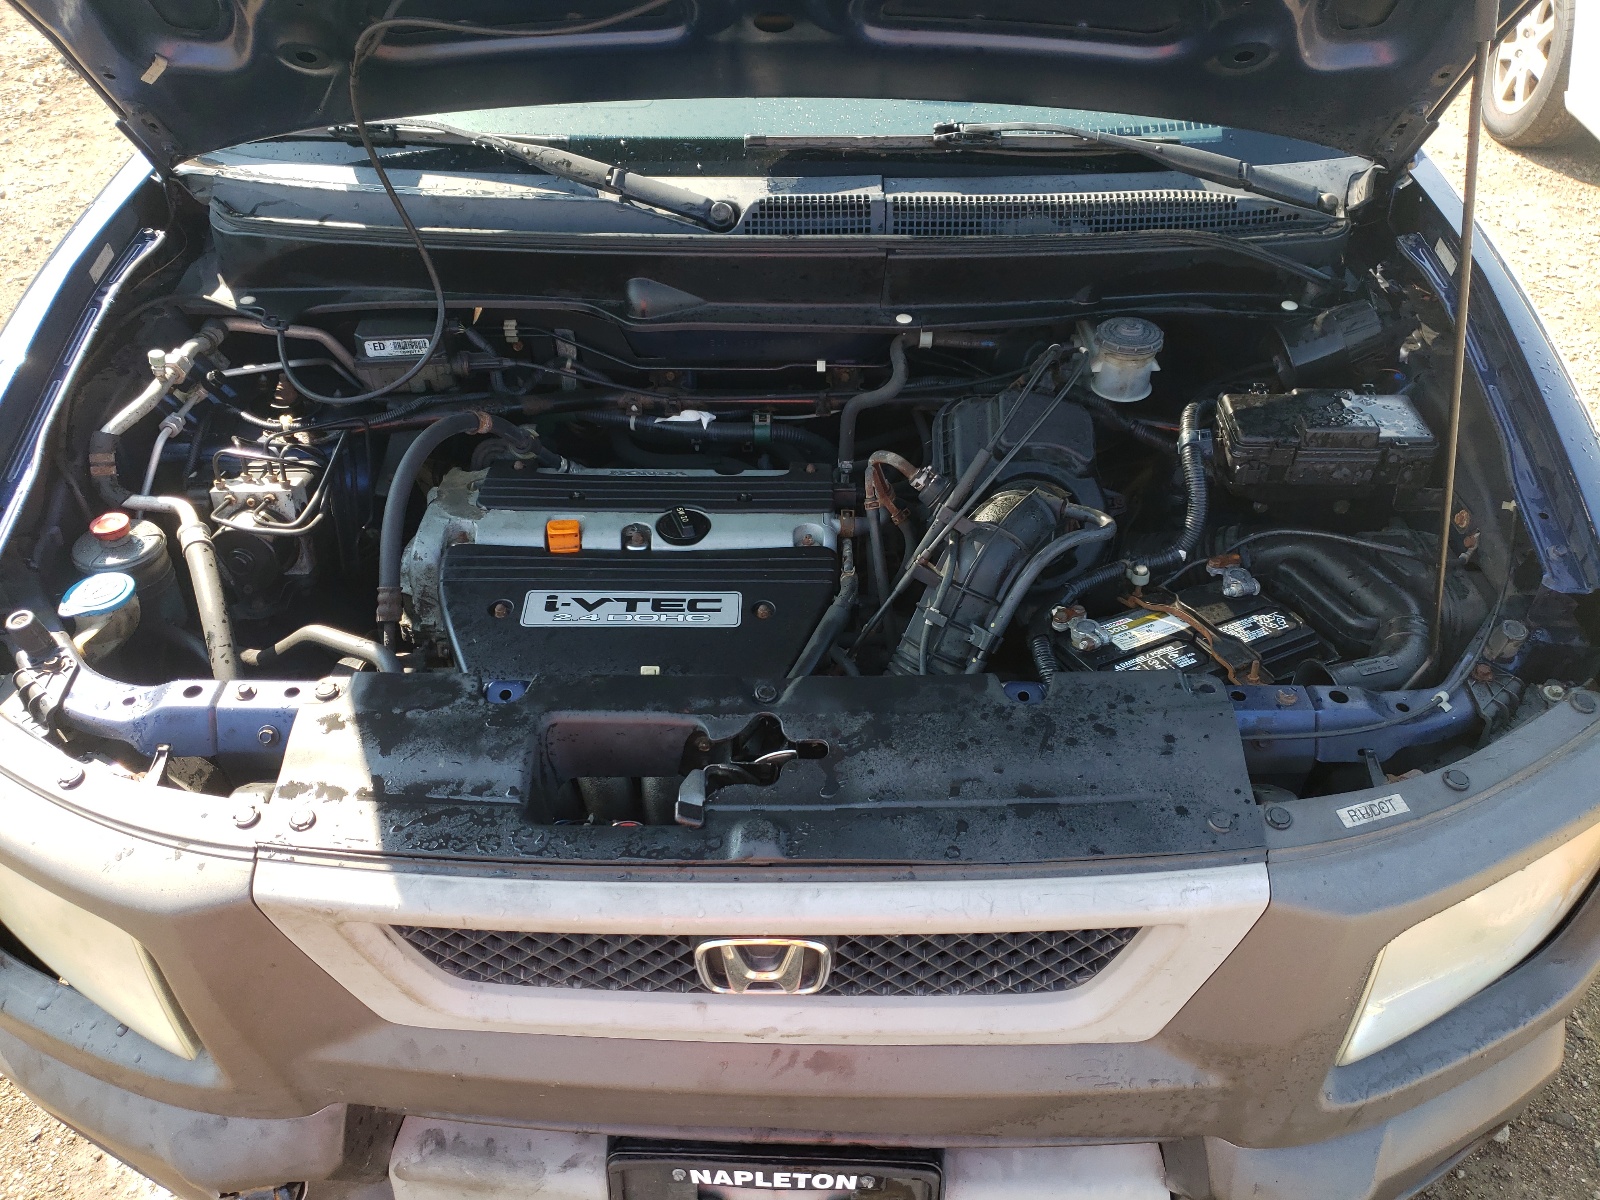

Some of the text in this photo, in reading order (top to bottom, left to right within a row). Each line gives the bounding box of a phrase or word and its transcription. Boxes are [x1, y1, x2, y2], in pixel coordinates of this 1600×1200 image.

[544, 594, 722, 613] i-VTEC
[552, 613, 711, 622] 2.4 DOHC
[689, 1169, 857, 1190] NAPLETON
